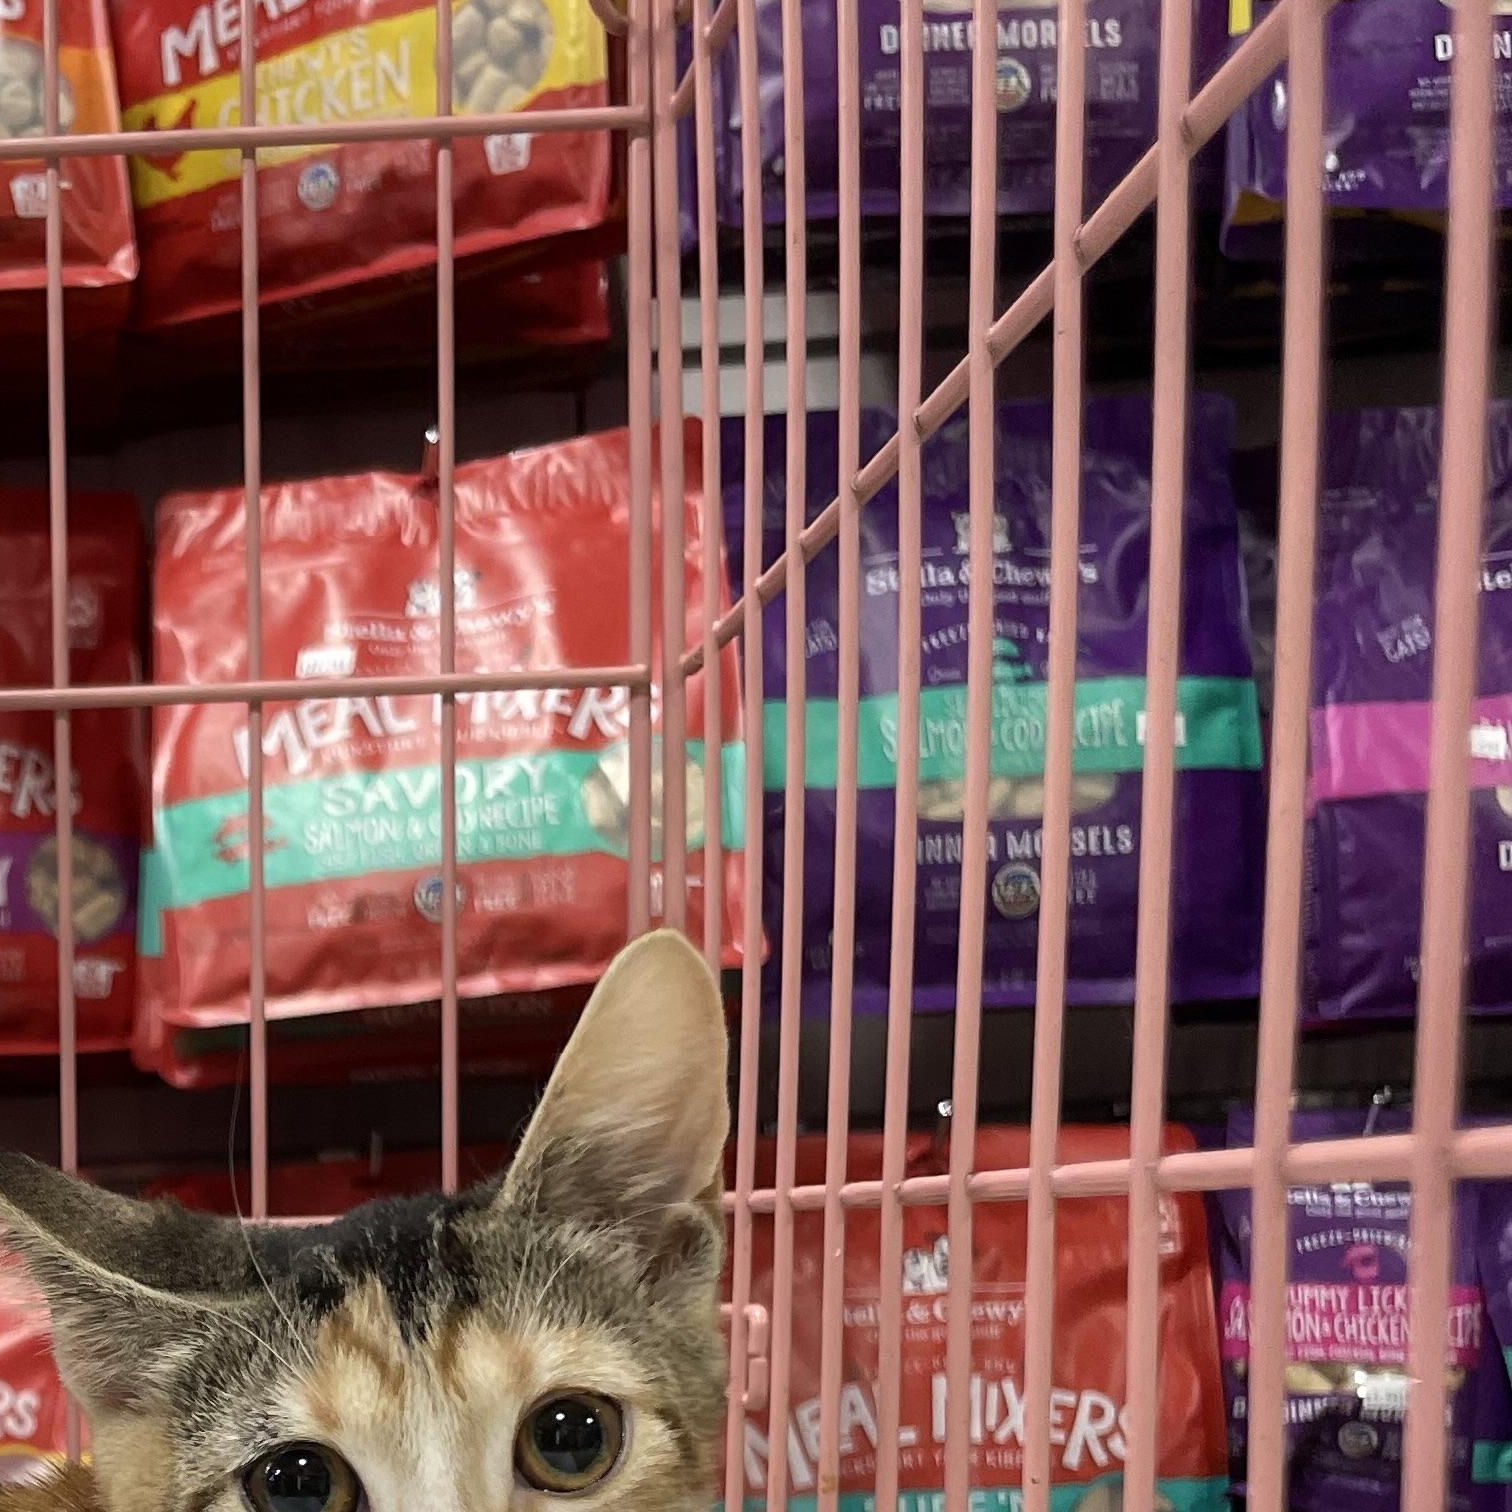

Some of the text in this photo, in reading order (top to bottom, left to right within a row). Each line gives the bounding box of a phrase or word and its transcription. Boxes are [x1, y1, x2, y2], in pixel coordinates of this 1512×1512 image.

[996, 18, 1123, 50] MORLS
[865, 562, 958, 597] Stlla
[993, 560, 1099, 587] Chew's
[432, 667, 661, 741] MIXER
[232, 696, 418, 779] MEAL
[321, 757, 547, 817] SAVORY
[428, 807, 477, 837] CD
[917, 824, 1134, 866] INNR MSELS
[1289, 1285, 1349, 1313] UMMY
[744, 1382, 918, 1490] MEA
